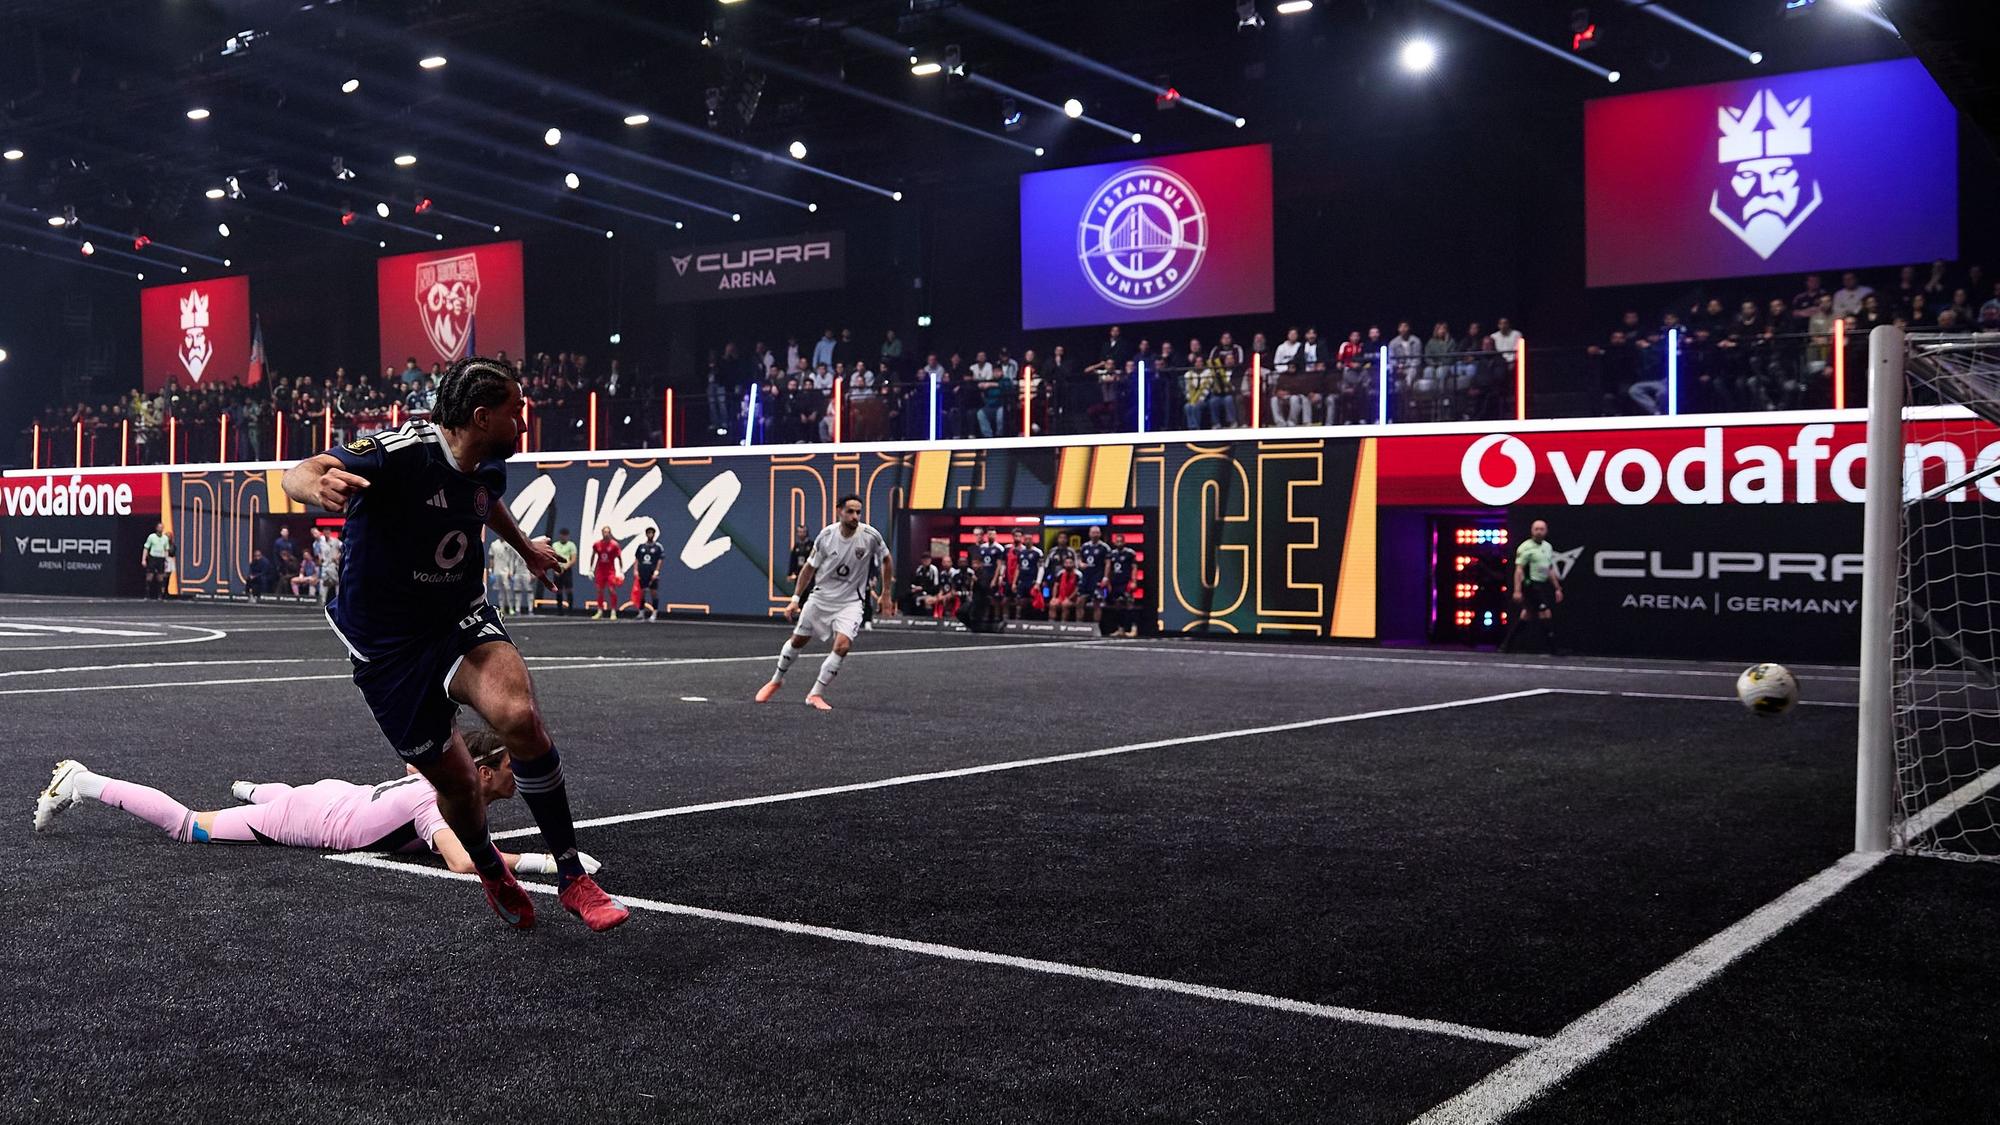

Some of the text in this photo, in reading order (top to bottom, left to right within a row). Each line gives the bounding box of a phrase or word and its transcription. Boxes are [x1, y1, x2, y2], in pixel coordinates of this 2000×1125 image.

[1097, 178, 1185, 217] ISTANBUL
[696, 241, 831, 272] CUPRA
[718, 269, 777, 290] ARENA
[1105, 267, 1179, 296] UNITED
[3, 475, 133, 517] vodafone
[679, 469, 742, 570] 2
[30, 538, 112, 554] CUPRA
[38, 561, 103, 570] ARENA GERMANY
[1622, 593, 1858, 616] ARENA GERMANY
